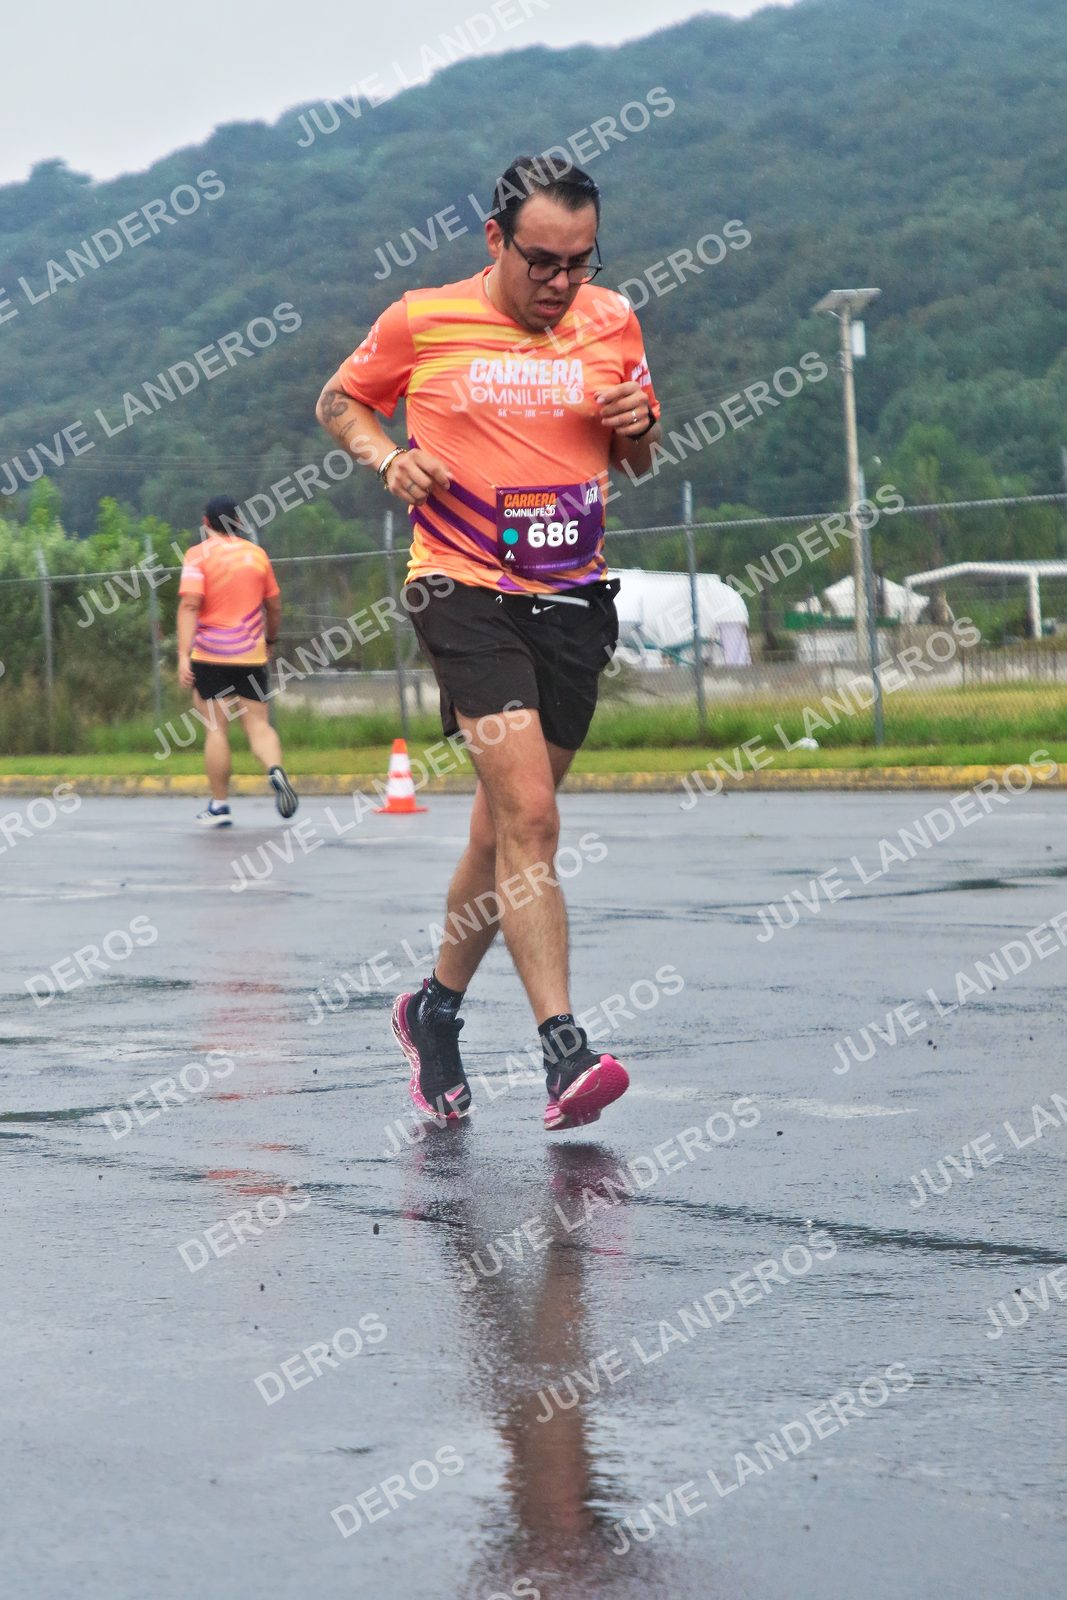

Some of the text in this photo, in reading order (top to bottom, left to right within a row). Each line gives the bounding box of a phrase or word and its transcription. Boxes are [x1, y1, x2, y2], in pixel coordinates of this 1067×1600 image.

[470, 358, 584, 385] CARRERA
[504, 493, 556, 508] CARRERA
[527, 520, 579, 548] 686
